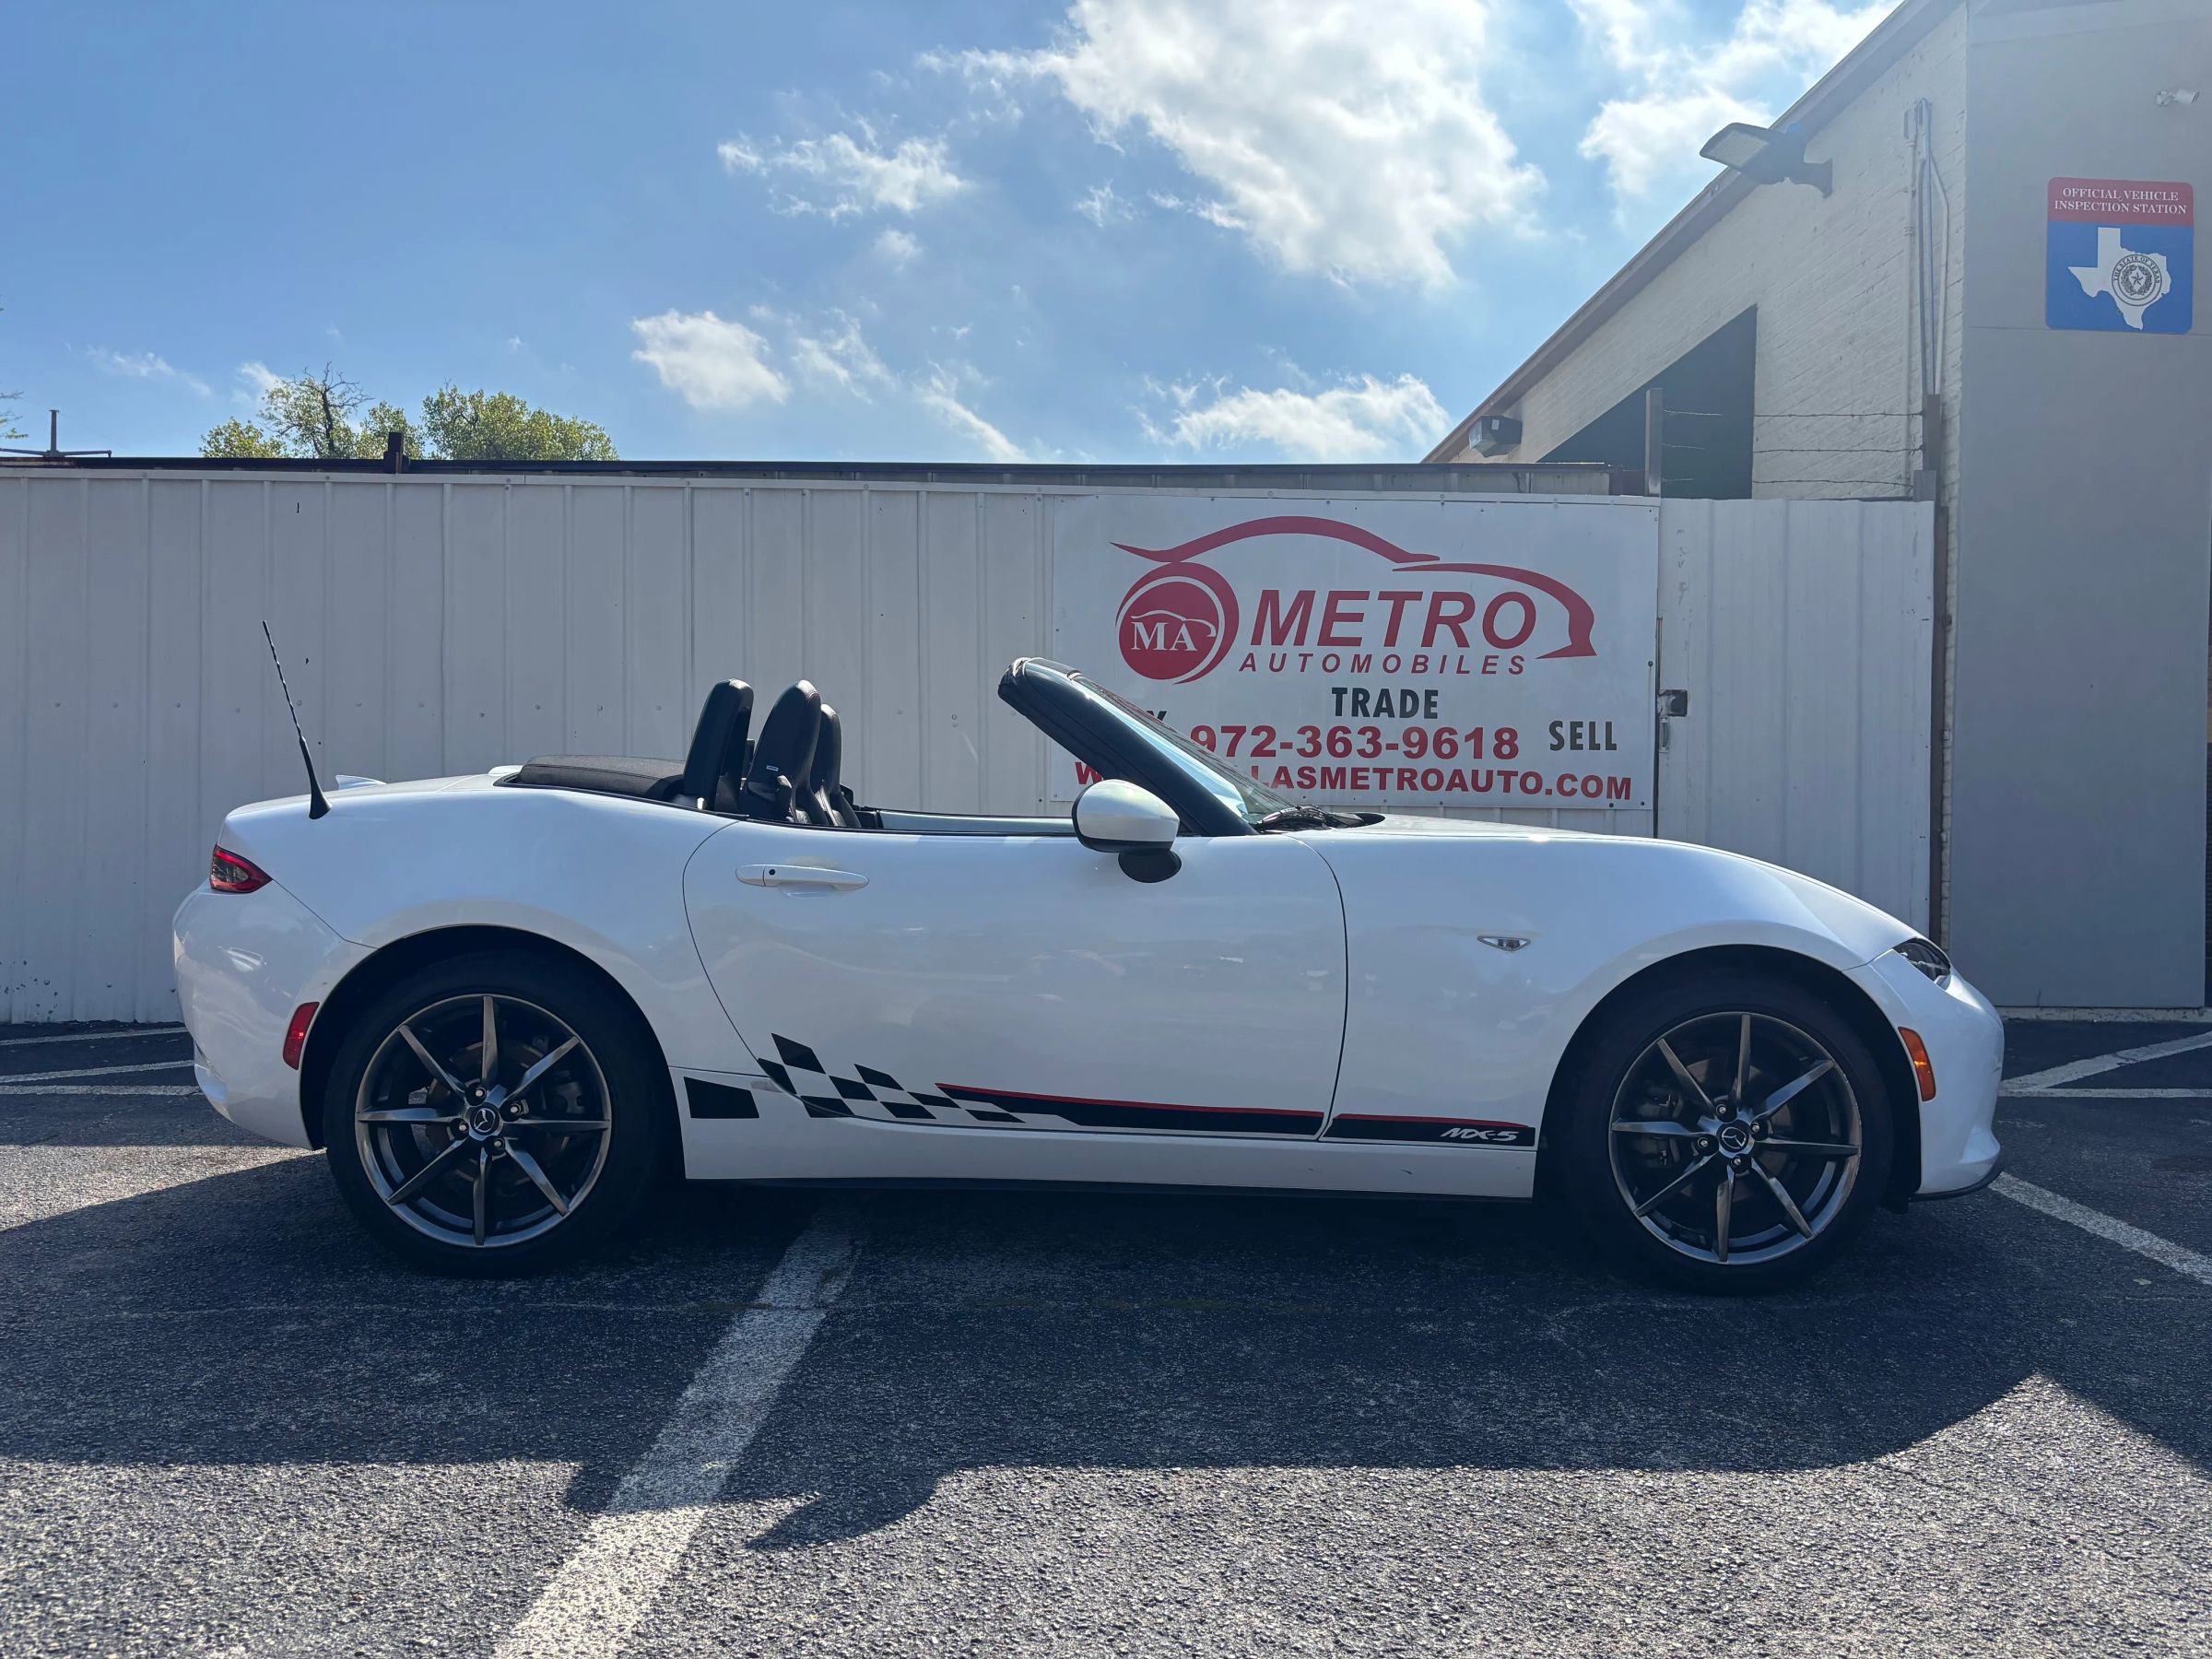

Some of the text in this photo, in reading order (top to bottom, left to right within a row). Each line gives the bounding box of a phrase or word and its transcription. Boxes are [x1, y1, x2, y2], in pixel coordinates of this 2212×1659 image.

[2054, 201, 2187, 215] INSPECTION STATION
[2063, 187, 2179, 201] OFFICIAL VEHICLE
[1250, 589, 1537, 650] METRO
[1131, 622, 1197, 651] MA
[1239, 652, 1525, 676] AUTOMOBILES
[1331, 687, 1439, 720] TRADE
[1190, 724, 1519, 760] 972-363-9618
[1548, 720, 1618, 752] SELL
[1440, 1127, 1519, 1141] MX-5
